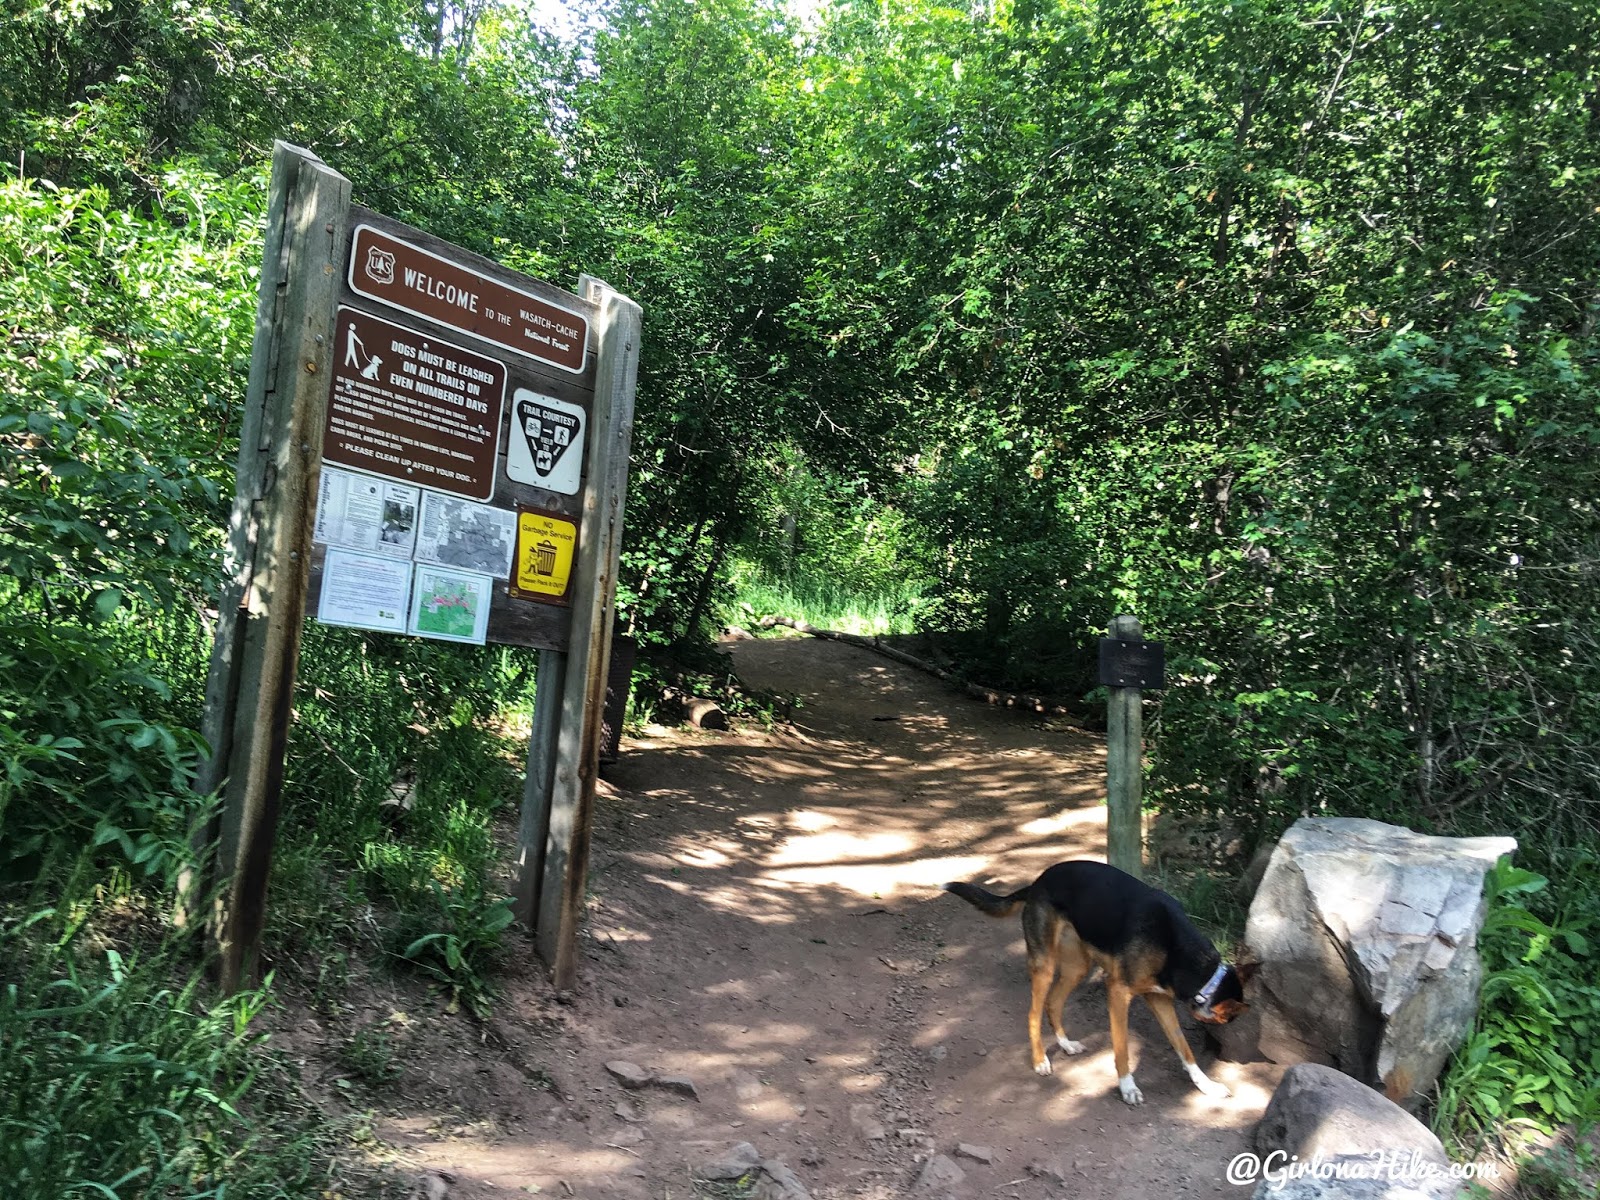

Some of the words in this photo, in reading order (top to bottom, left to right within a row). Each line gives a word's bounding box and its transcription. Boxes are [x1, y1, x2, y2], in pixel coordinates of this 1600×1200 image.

[405, 267, 479, 314] WELCOME
[485, 308, 494, 320] TO
[498, 312, 512, 326] THE
[520, 309, 578, 340] WASATCH-CACHE
[524, 328, 550, 345] National
[552, 338, 570, 352] Forest
[391, 340, 416, 358] DOGS
[418, 350, 444, 368] MUST
[446, 359, 456, 371] BE
[458, 363, 494, 385] LEASHED
[403, 361, 417, 375] ON
[418, 366, 434, 381] ALL
[436, 372, 466, 391] TRAILS
[467, 383, 480, 396] ON
[390, 373, 414, 390] EVEN
[415, 381, 464, 406] NUMBERED
[466, 398, 488, 414] DAYS
[523, 404, 541, 418] TRAIL
[542, 410, 576, 427] COURTESY
[345, 443, 374, 457] PLEASE
[375, 451, 400, 464] CLEAN
[401, 458, 412, 466] UP
[412, 461, 435, 473] AFTER
[436, 467, 454, 478] YOUR
[522, 524, 548, 536] Garbage
[550, 530, 572, 540] Service
